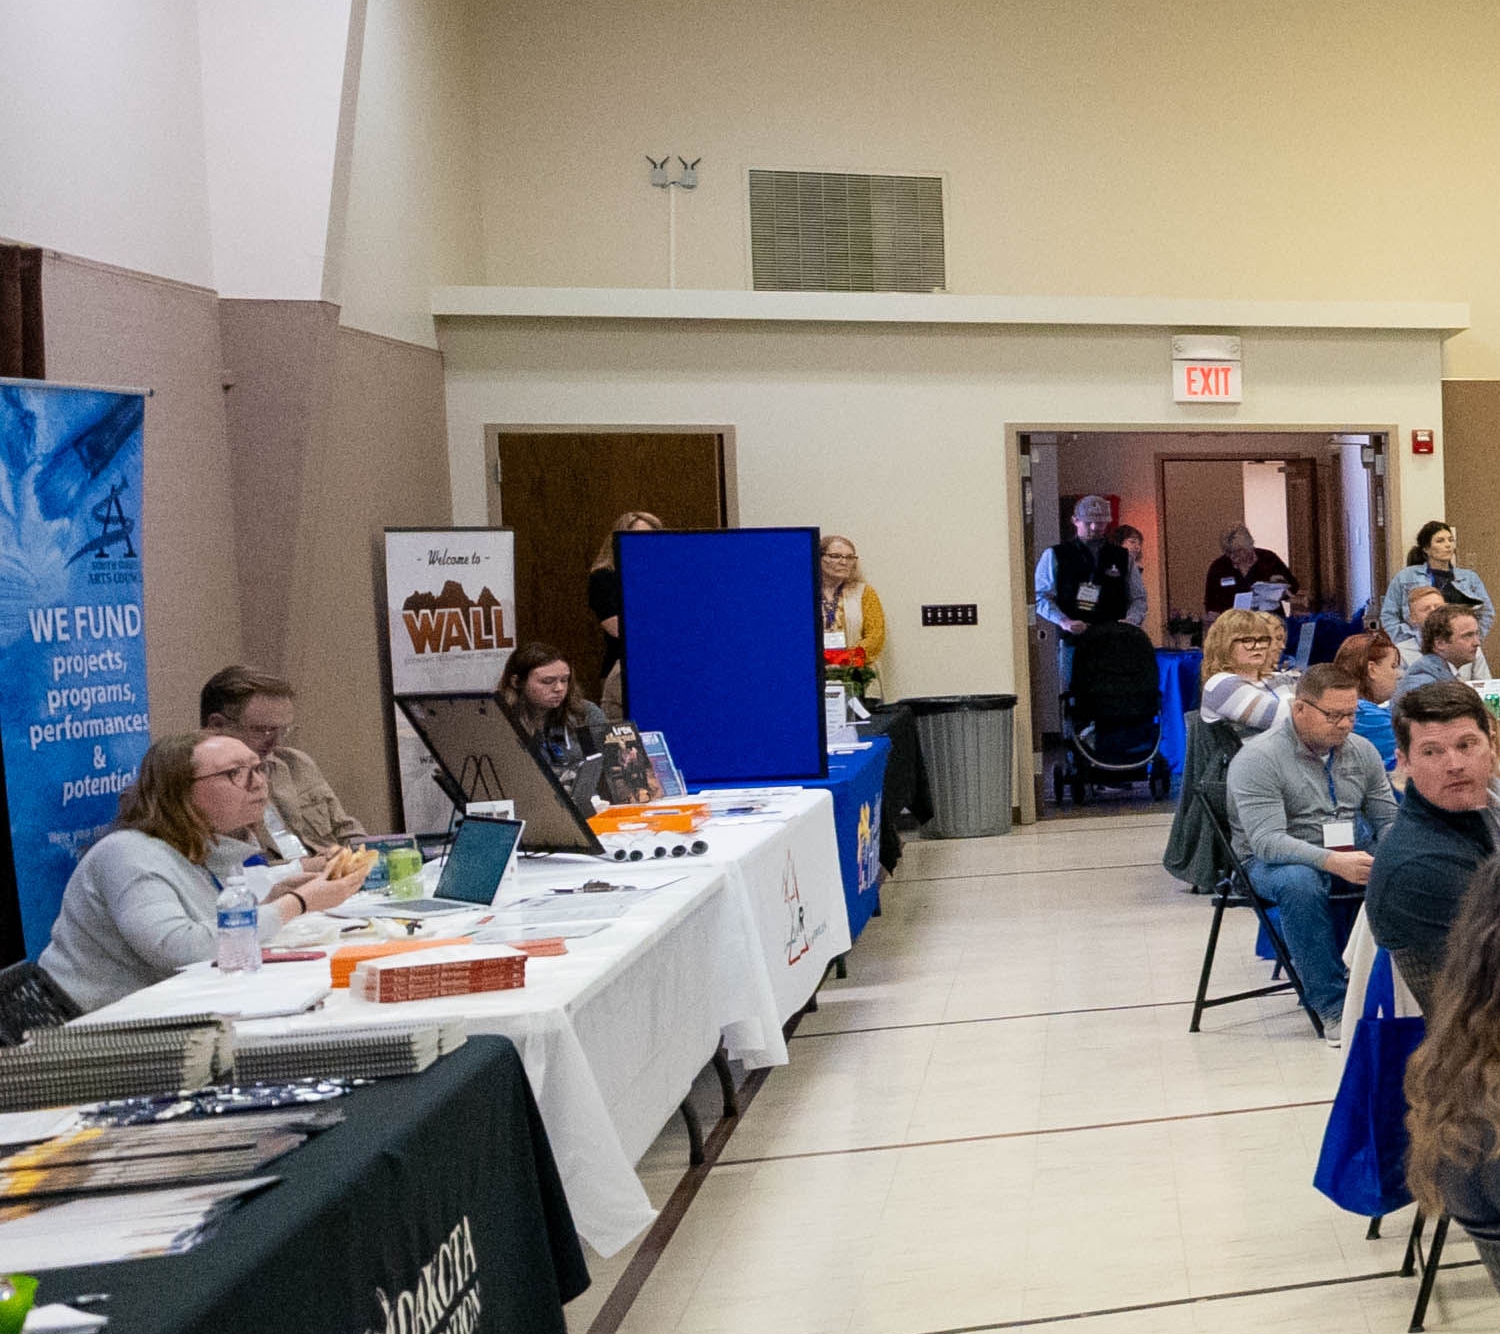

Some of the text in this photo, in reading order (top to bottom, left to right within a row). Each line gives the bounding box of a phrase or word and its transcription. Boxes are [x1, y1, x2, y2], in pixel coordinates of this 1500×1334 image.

[1185, 367, 1231, 396] EXIT
[428, 548, 481, 566] Welcome to
[28, 603, 142, 643] WE FUND
[402, 605, 515, 655] WALL
[53, 650, 127, 681] projects,
[47, 683, 136, 715] programs,
[30, 713, 149, 750] performances
[93, 745, 107, 769] &
